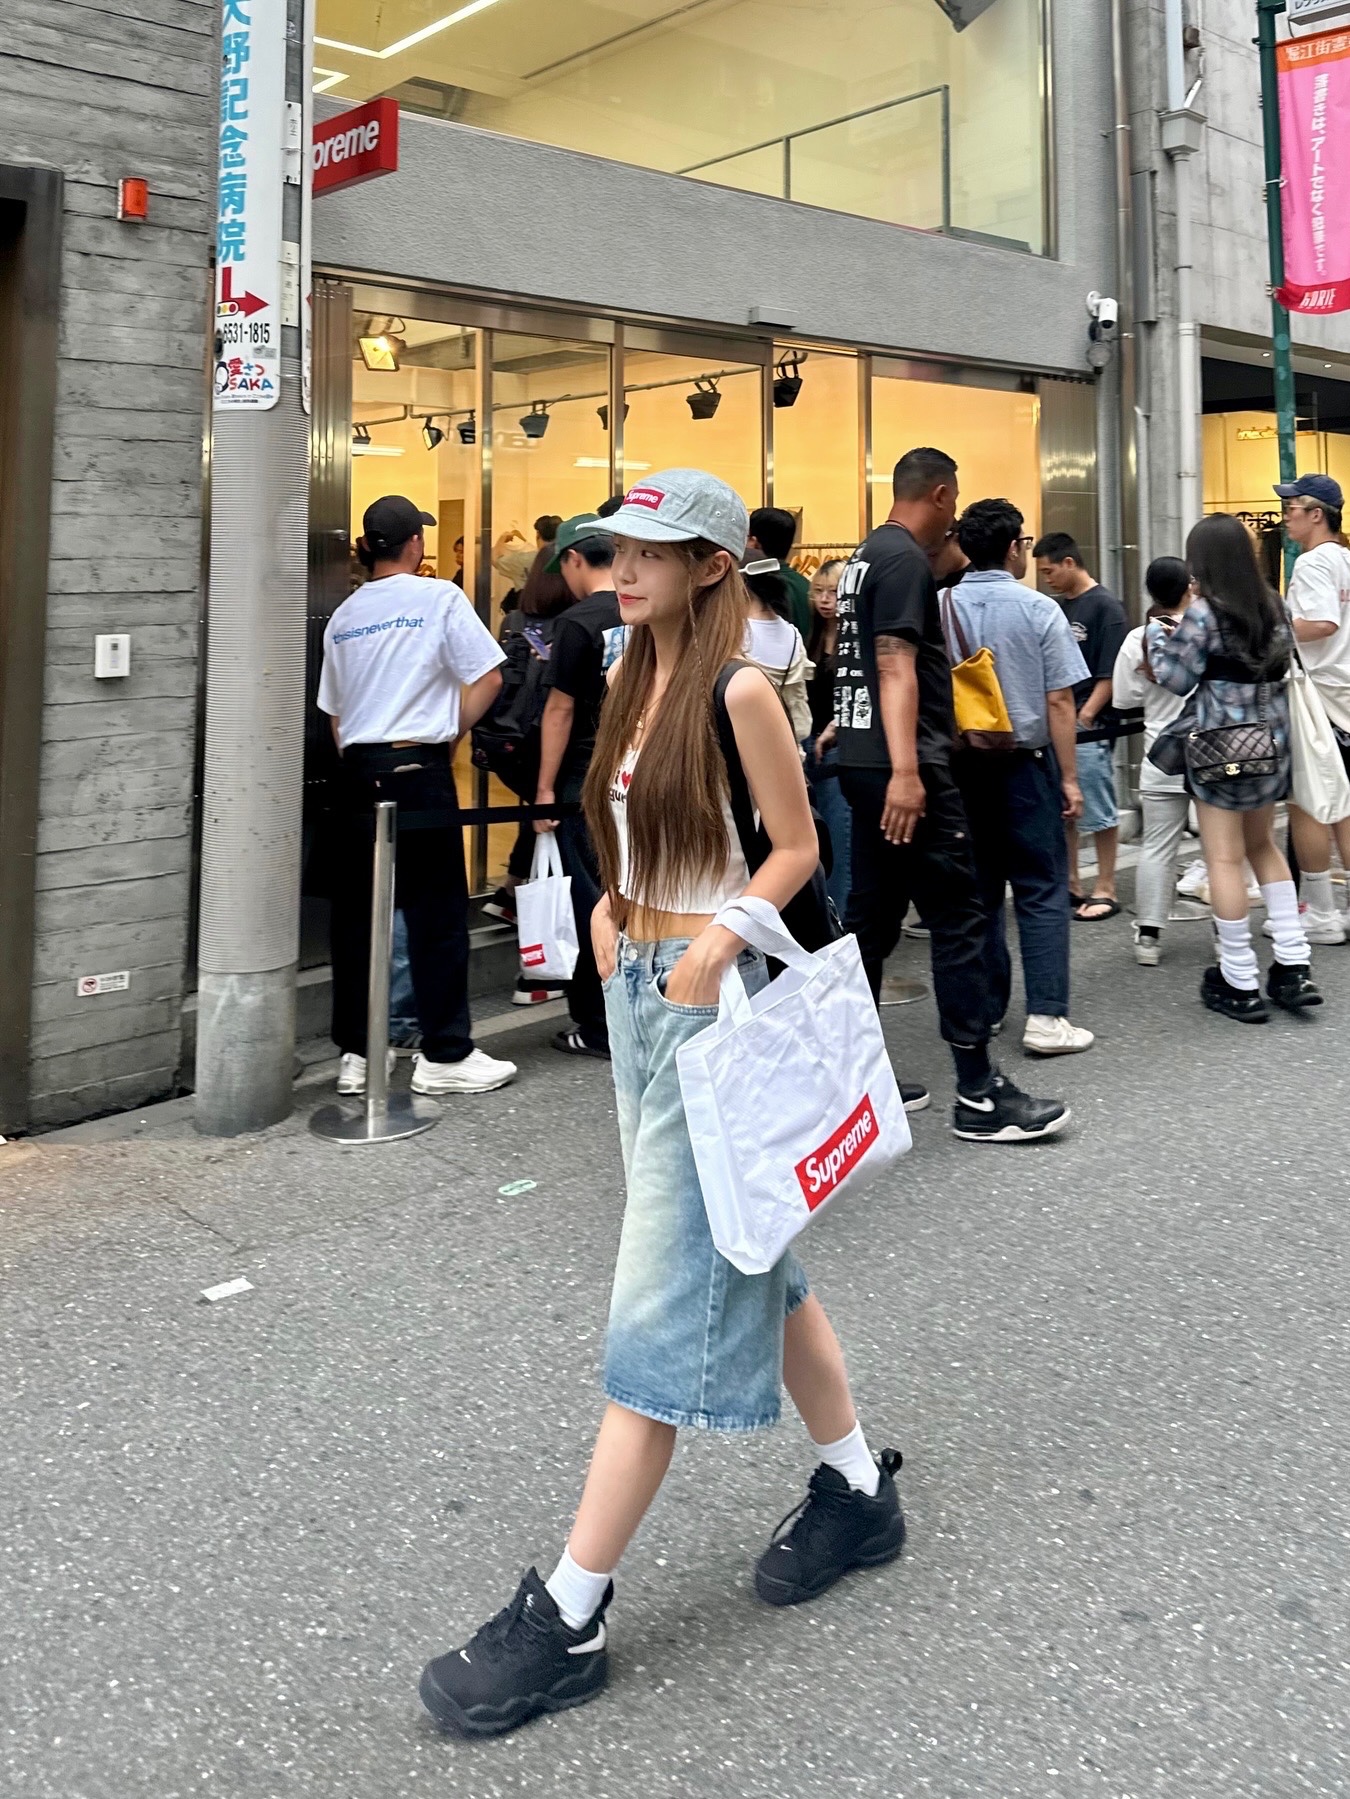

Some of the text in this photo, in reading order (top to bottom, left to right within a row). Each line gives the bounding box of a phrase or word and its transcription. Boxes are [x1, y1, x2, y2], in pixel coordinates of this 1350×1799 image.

[217, 0, 251, 263] 大野記念病院
[312, 120, 380, 171] preme
[626, 490, 659, 504] Supreme
[332, 616, 425, 645] tsisneverthat
[805, 1110, 873, 1193] Supreme
